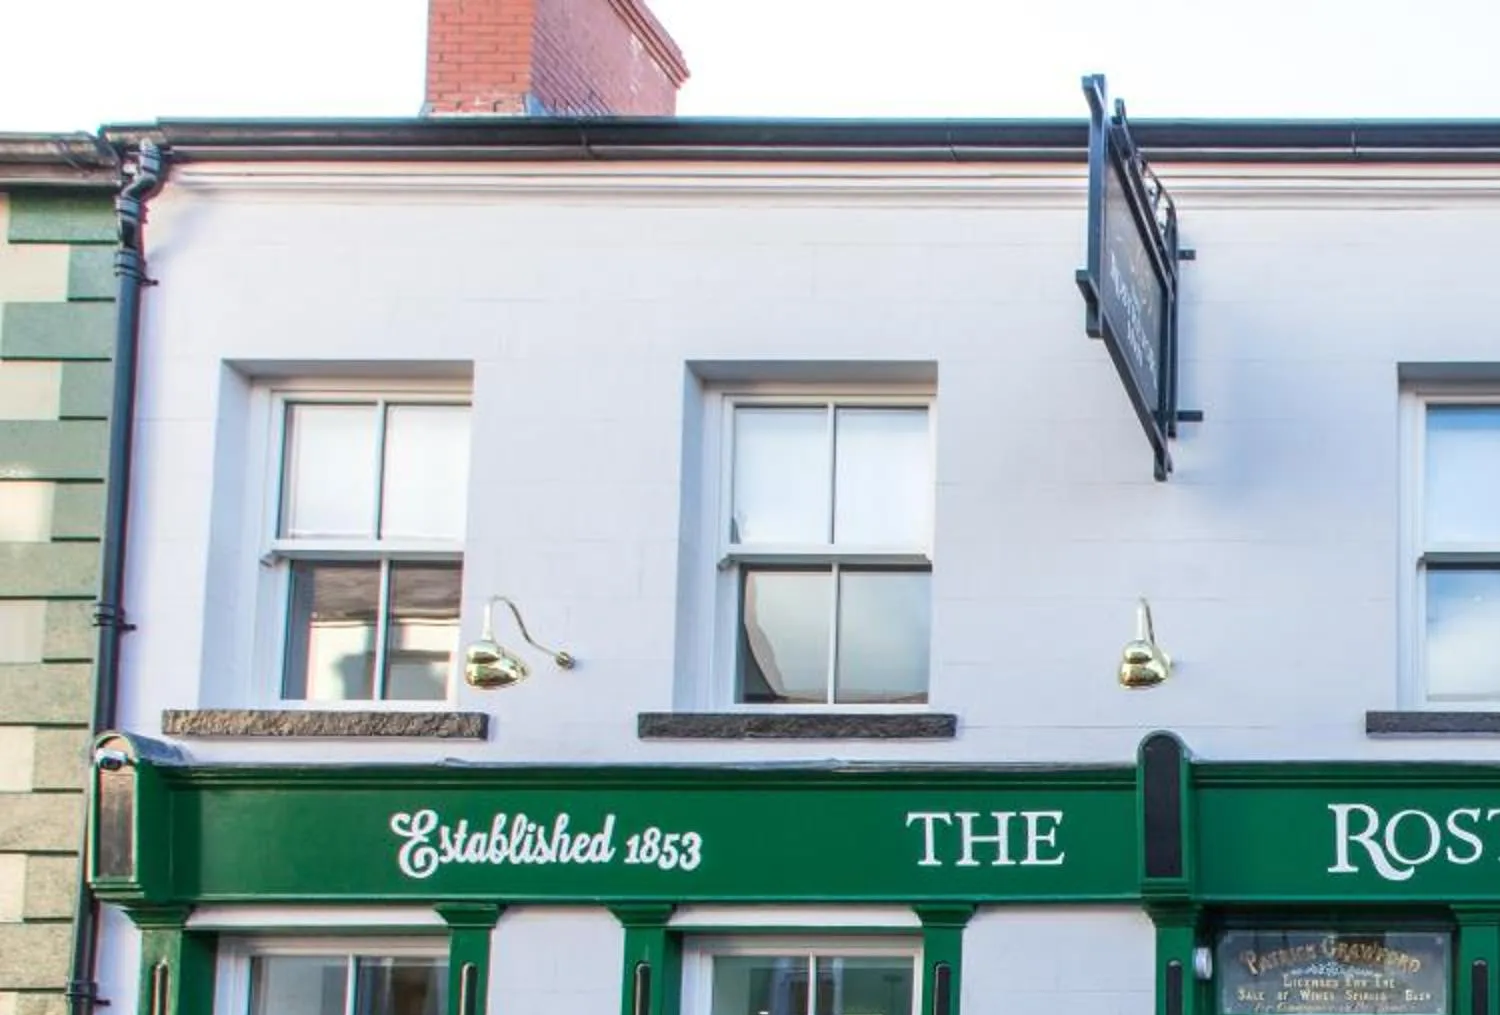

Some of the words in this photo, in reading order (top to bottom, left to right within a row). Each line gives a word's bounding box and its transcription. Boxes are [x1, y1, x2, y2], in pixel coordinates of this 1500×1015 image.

[390, 809, 617, 879] Established
[623, 825, 703, 871] 1853
[906, 810, 1066, 867] THE
